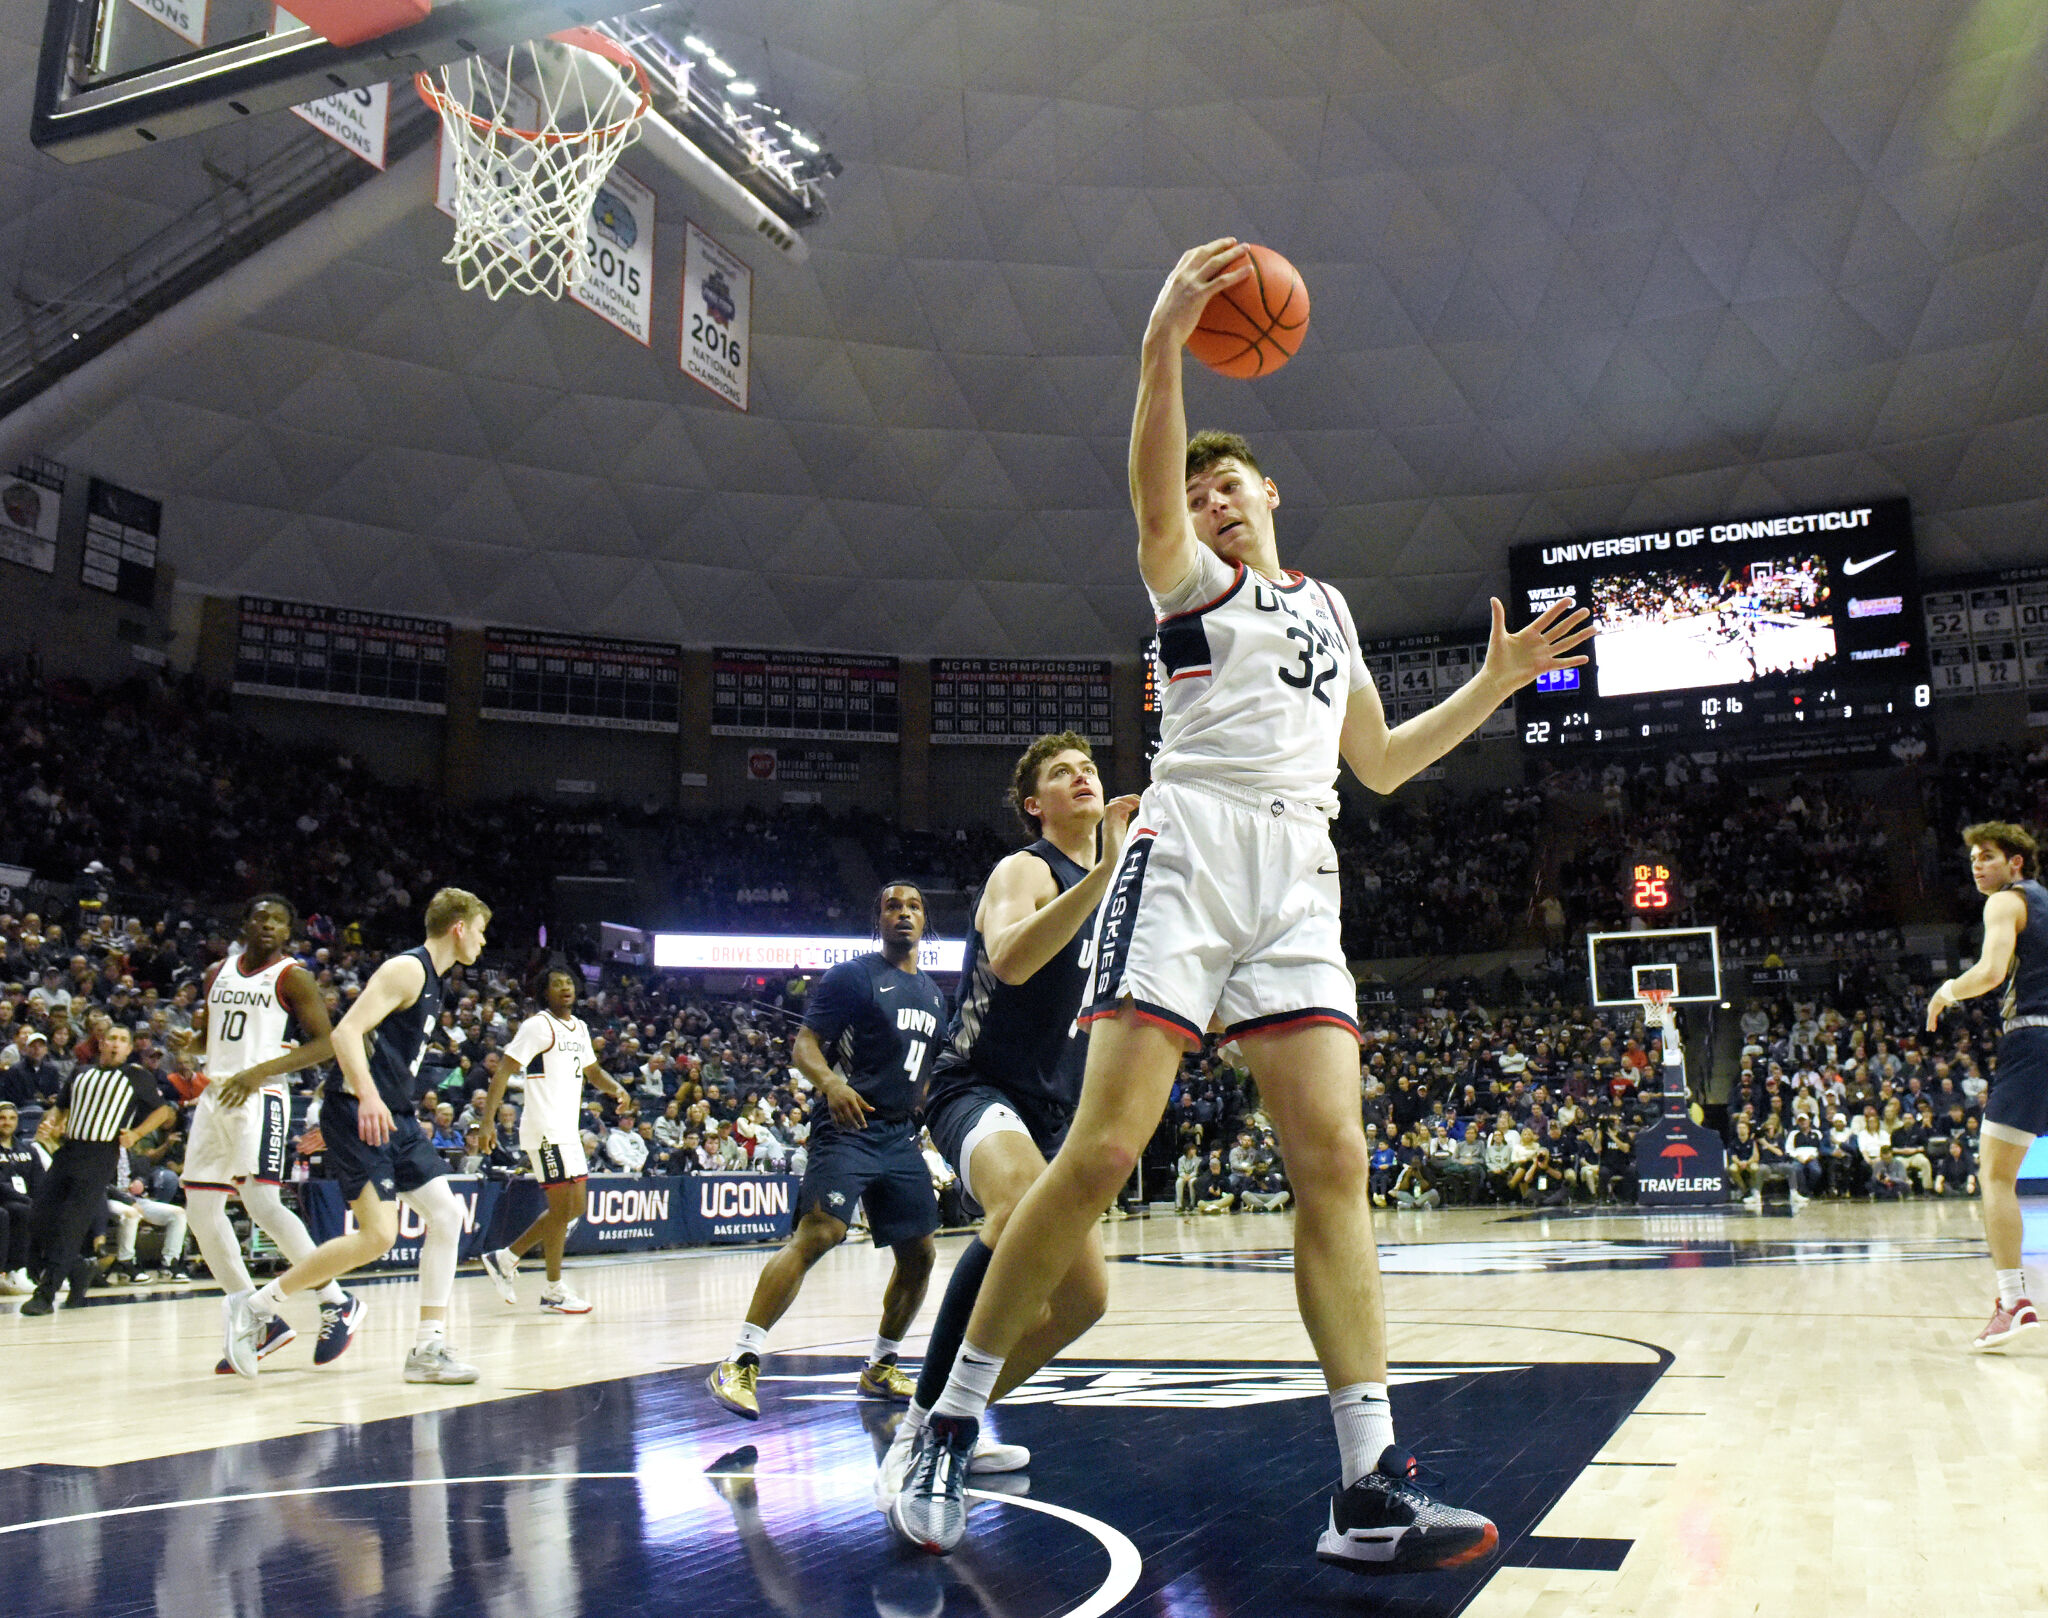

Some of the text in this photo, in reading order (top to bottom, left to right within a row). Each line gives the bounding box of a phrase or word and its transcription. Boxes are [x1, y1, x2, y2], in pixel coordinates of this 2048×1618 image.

[587, 237, 641, 297] 2015
[588, 273, 638, 315] NATIONAL
[579, 287, 643, 337] CHAMPIONS
[692, 315, 741, 368] 2016
[693, 346, 738, 384] NATIONAL
[687, 361, 741, 403] CHAMPIONS
[1542, 508, 1872, 565] UNIVERSITY OF CONNECTICUT
[1527, 585, 1577, 601] WELLS
[336, 610, 448, 635] CONFERENCE
[1933, 614, 1962, 633] 52
[1401, 635, 1440, 646] HONOR
[1850, 647, 1901, 661] TRAVELERS
[942, 661, 1101, 673] NCAA CHAMPIONSHIP
[1278, 626, 1338, 708] 32
[1537, 669, 1575, 684] CBS
[940, 673, 1104, 682] TOURNAMENT APPEARANCES
[1403, 671, 1430, 688] 44
[1914, 684, 1930, 707] 8
[1701, 697, 1742, 716] 10:16
[1795, 710, 1805, 721] 4
[1844, 705, 1853, 718] 3
[716, 726, 788, 737] CONNECTICUT
[935, 736, 1005, 744] CONNECTICUT
[1526, 721, 1550, 743] 22
[1595, 729, 1602, 741] 3
[1642, 724, 1650, 737] 0
[1635, 864, 1669, 880] 10:16
[1635, 881, 1668, 908] 25
[1097, 851, 1142, 995] HUSKIES
[712, 946, 752, 963] DRIVE
[757, 947, 802, 963] SOBER
[824, 948, 847, 963] GET
[1777, 968, 1799, 981] 116
[211, 989, 272, 1009] UCONN
[1375, 990, 1394, 1002] 114
[221, 1010, 247, 1042] 10
[897, 1008, 937, 1038] UNH
[573, 1056, 582, 1079] 2
[903, 1040, 927, 1082] 4
[267, 1099, 284, 1173] HUSKIES
[1638, 1177, 1722, 1193] TRAVELERS
[587, 1190, 670, 1225] UCONN
[701, 1182, 788, 1218] UCONN
[599, 1229, 655, 1241] BASKETBALL
[714, 1223, 776, 1236] BASKETBALL
